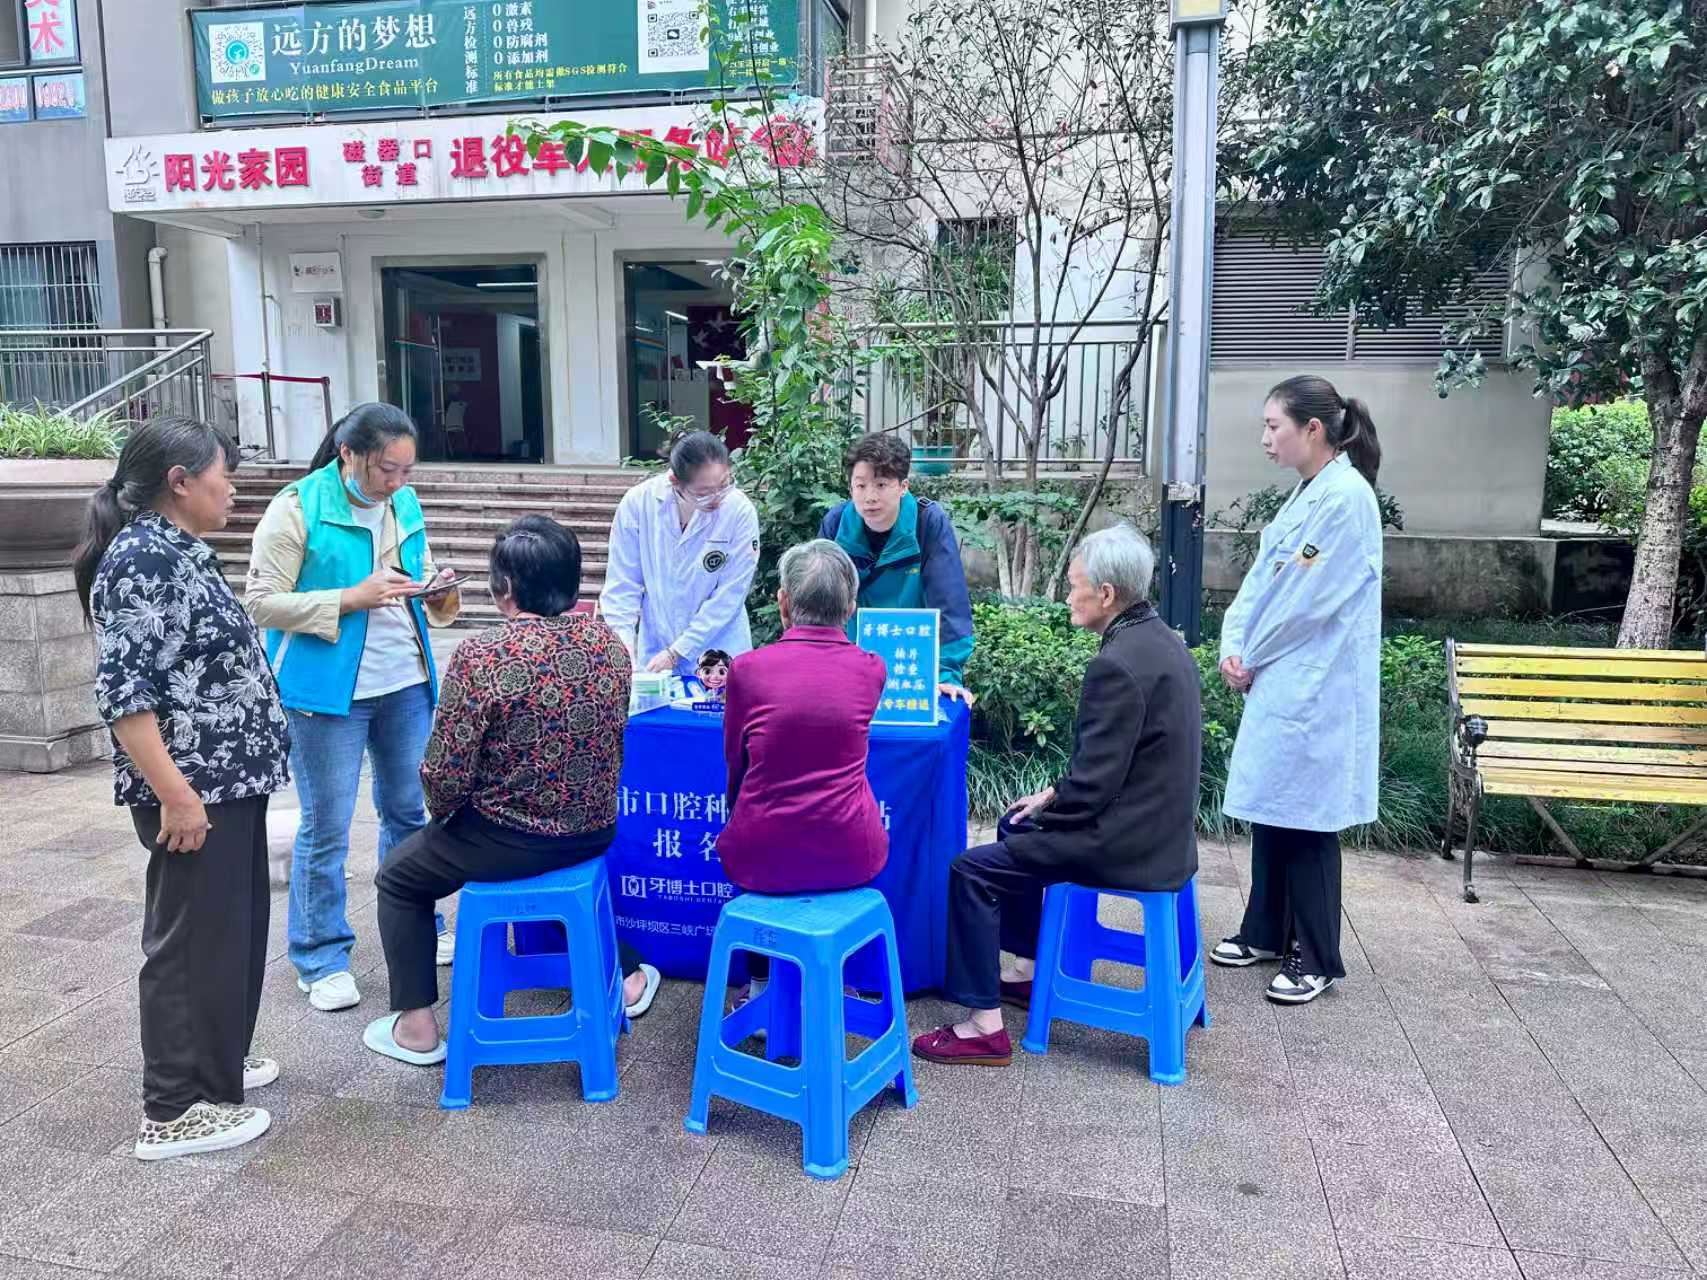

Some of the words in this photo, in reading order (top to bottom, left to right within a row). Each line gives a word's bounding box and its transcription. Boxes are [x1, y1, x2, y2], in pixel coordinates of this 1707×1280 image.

[271, 13, 438, 57] 远方的梦想
[463, 6, 479, 94] 远方检测标准
[289, 56, 419, 76] YuanfangDream
[211, 77, 438, 105] 做孩子放心吃的健康安全食品平台
[342, 139, 433, 163] 磁器口
[163, 146, 310, 192] 阳光家园
[361, 164, 418, 188] 街道
[649, 877, 734, 899] 牙博士口腔
